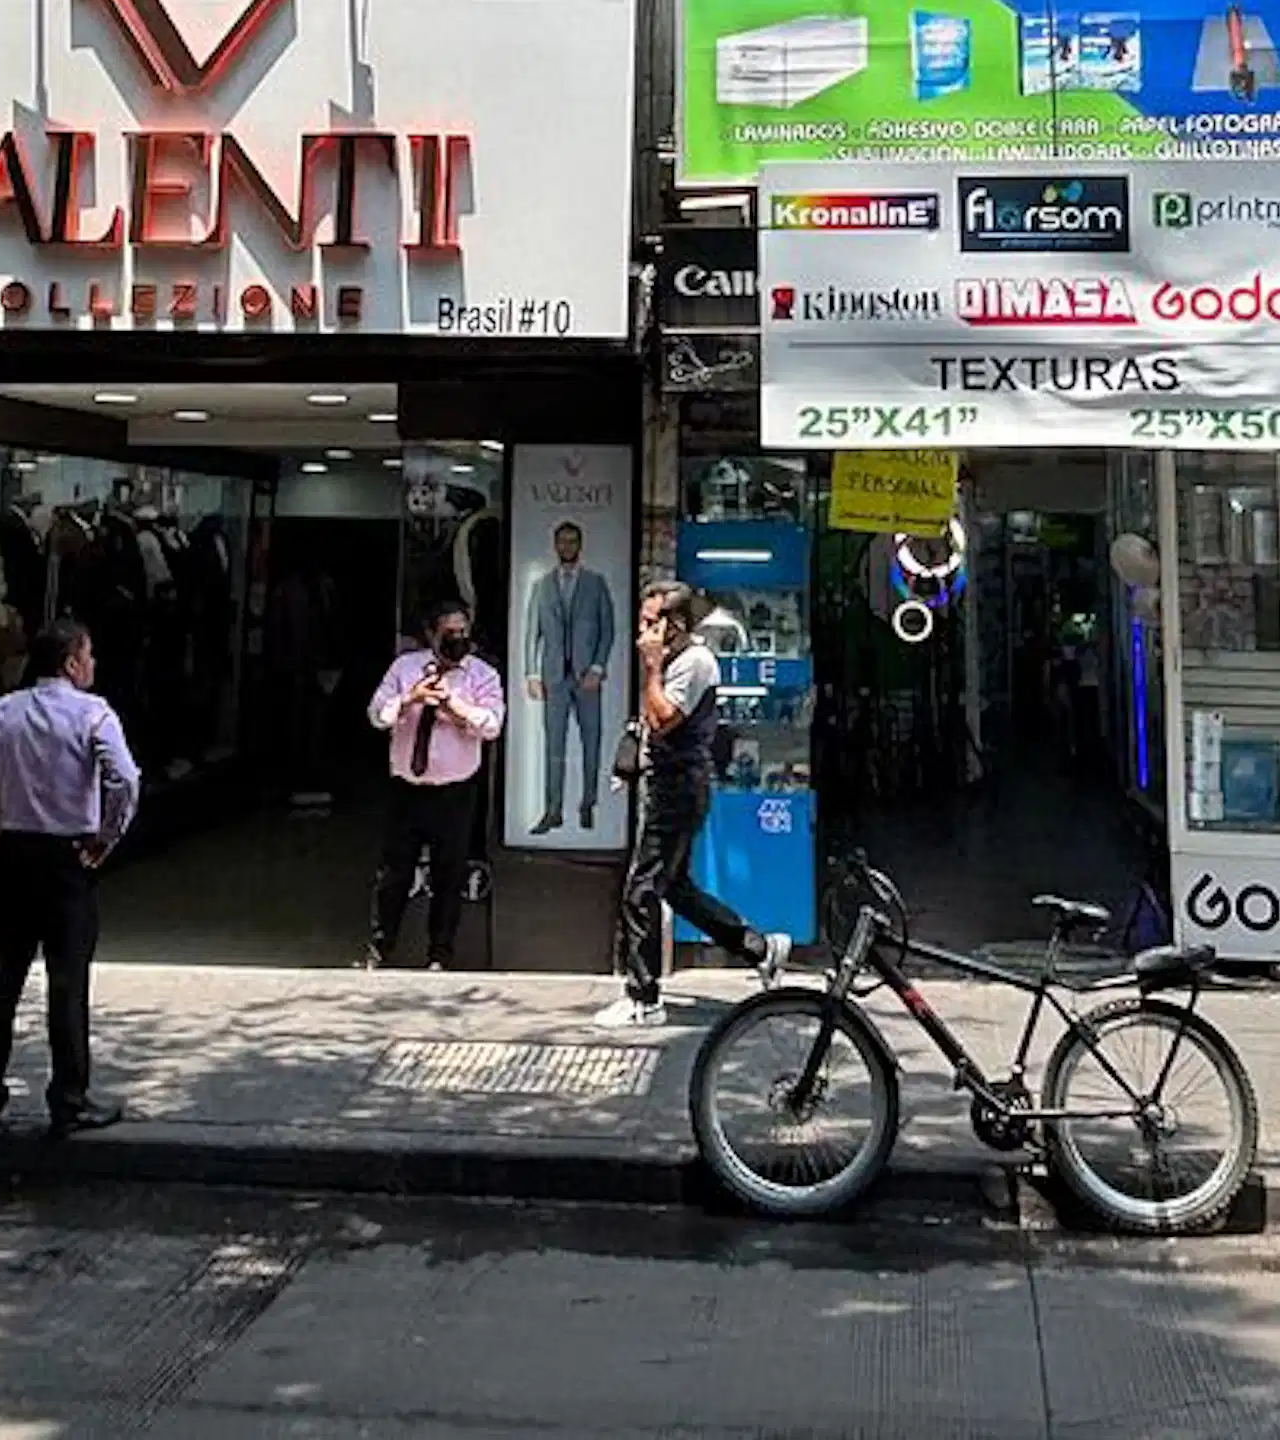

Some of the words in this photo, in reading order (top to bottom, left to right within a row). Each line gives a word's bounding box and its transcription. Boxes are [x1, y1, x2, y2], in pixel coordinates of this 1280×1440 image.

[735, 122, 846, 141] LAMINADOS
[871, 120, 967, 140] ADHESIVO
[674, 264, 758, 296] Can
[437, 297, 515, 335] Brasil
[518, 299, 572, 335] #10
[955, 275, 1137, 325] DIMASA
[930, 357, 1180, 392] TEXTURAS
